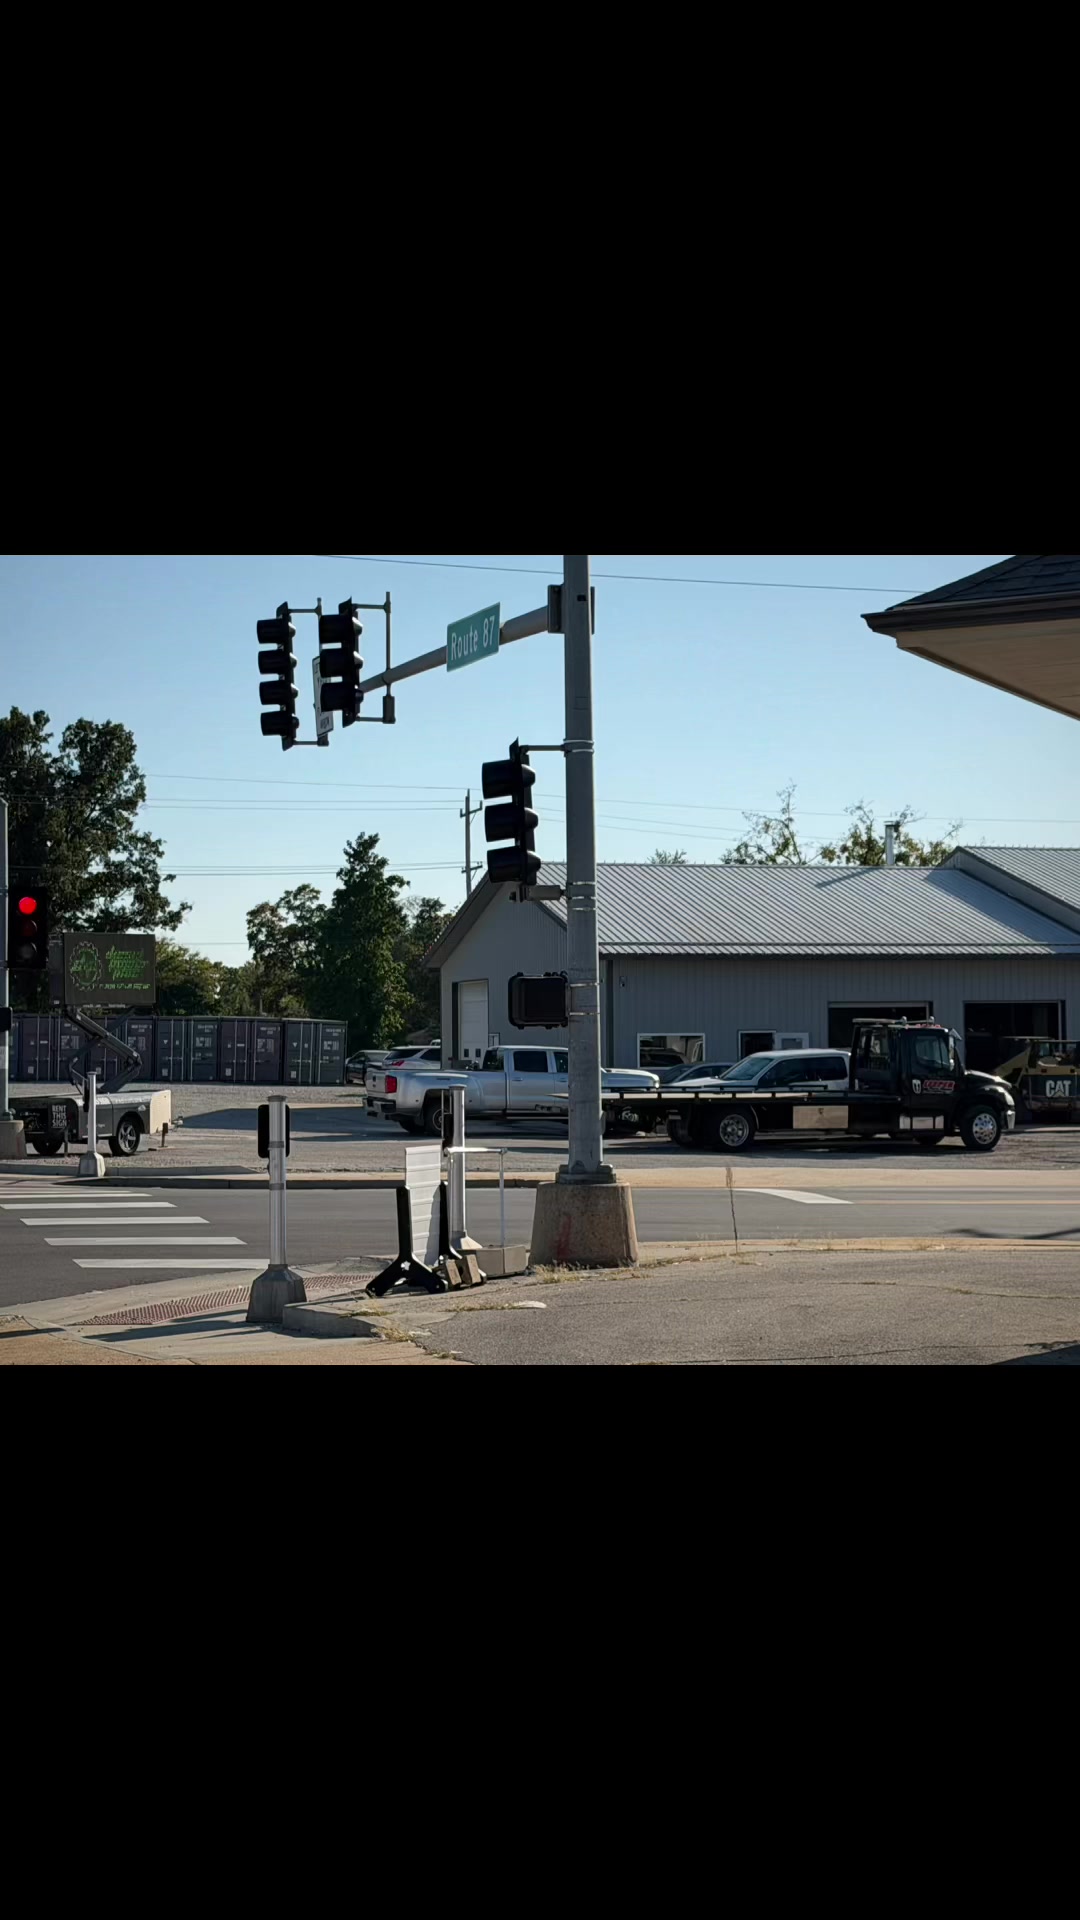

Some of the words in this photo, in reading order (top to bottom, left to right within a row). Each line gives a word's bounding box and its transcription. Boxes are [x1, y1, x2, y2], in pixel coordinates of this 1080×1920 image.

[451, 624, 478, 661] Route
[483, 615, 496, 648] 87
[1046, 1080, 1071, 1097] CAT
[52, 1112, 66, 1120] THIS
